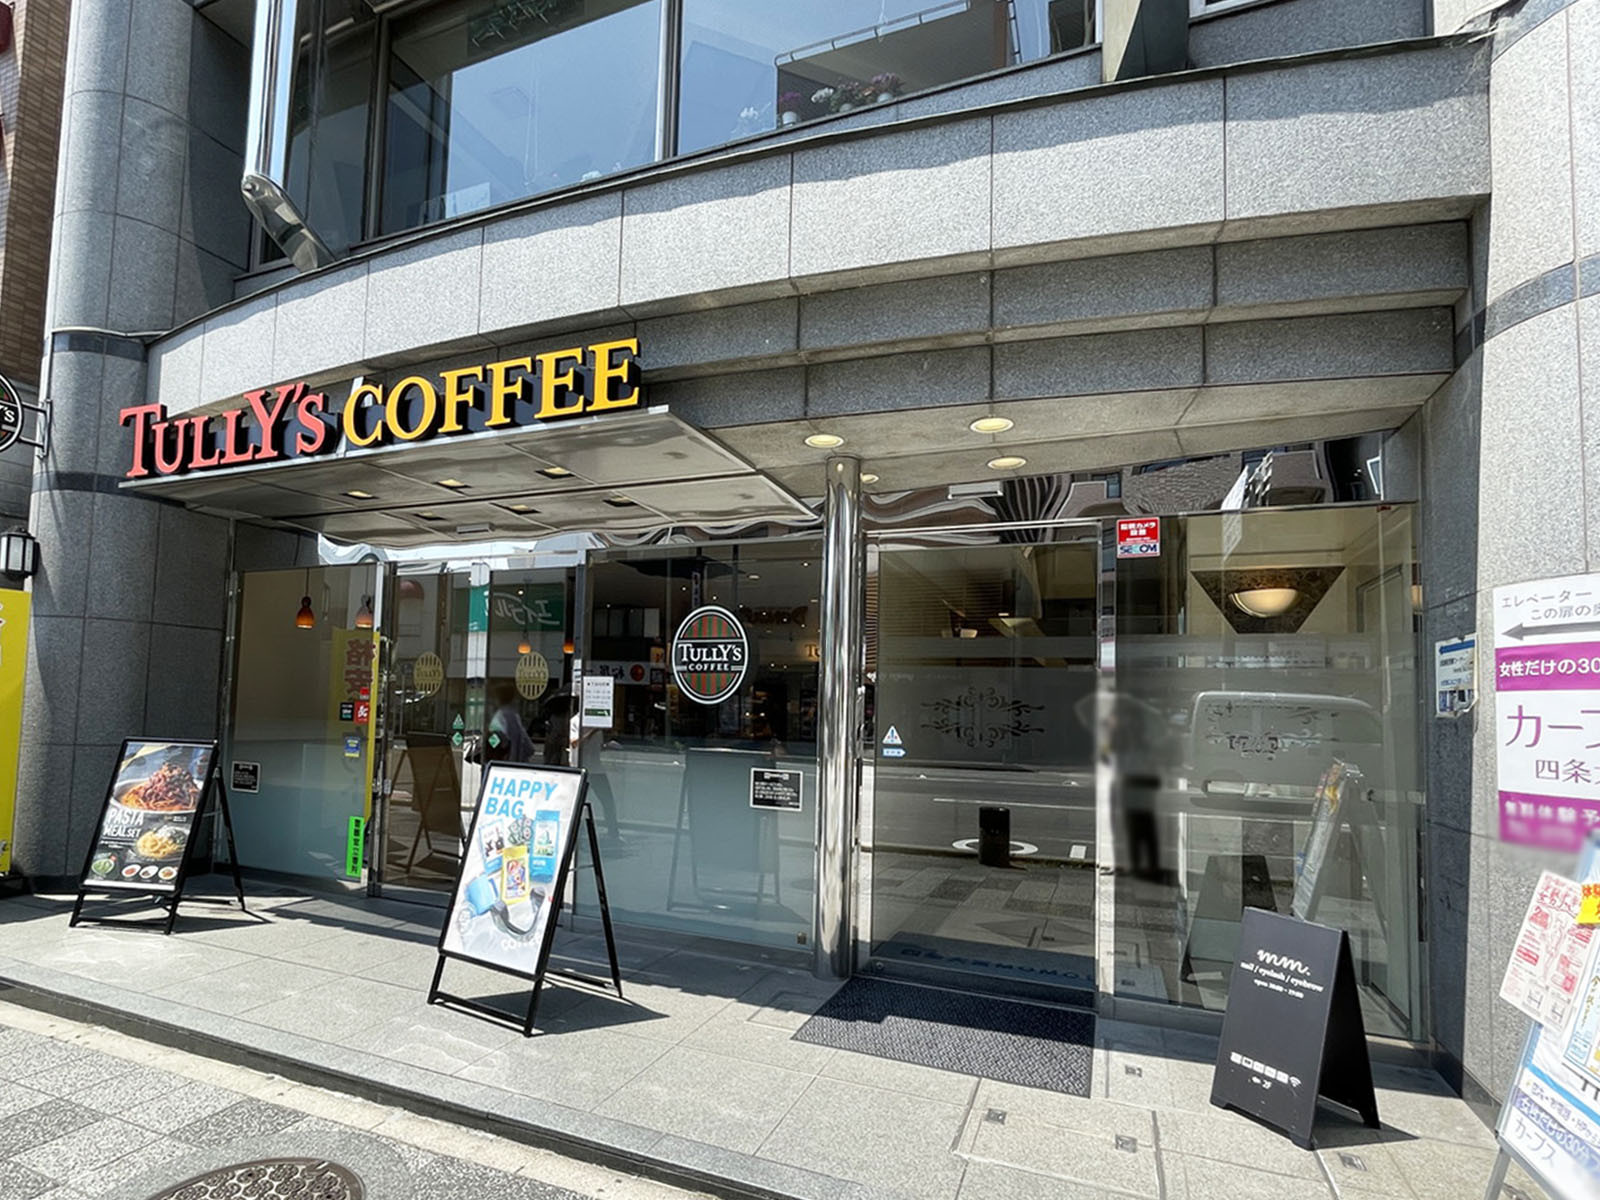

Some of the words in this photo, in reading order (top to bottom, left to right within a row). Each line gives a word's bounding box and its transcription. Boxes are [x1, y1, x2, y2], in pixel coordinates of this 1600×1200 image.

[343, 338, 639, 447] COFFEE
[1120, 544, 1157, 554] SECOM
[1502, 590, 1592, 608] エレベーター
[689, 663, 730, 671] COFFEE
[1499, 658, 1600, 677] 女性だけの30
[1536, 759, 1600, 785] 四条
[490, 776, 558, 801] HAPPY
[107, 808, 145, 826] PASTA
[485, 797, 524, 820] BAG
